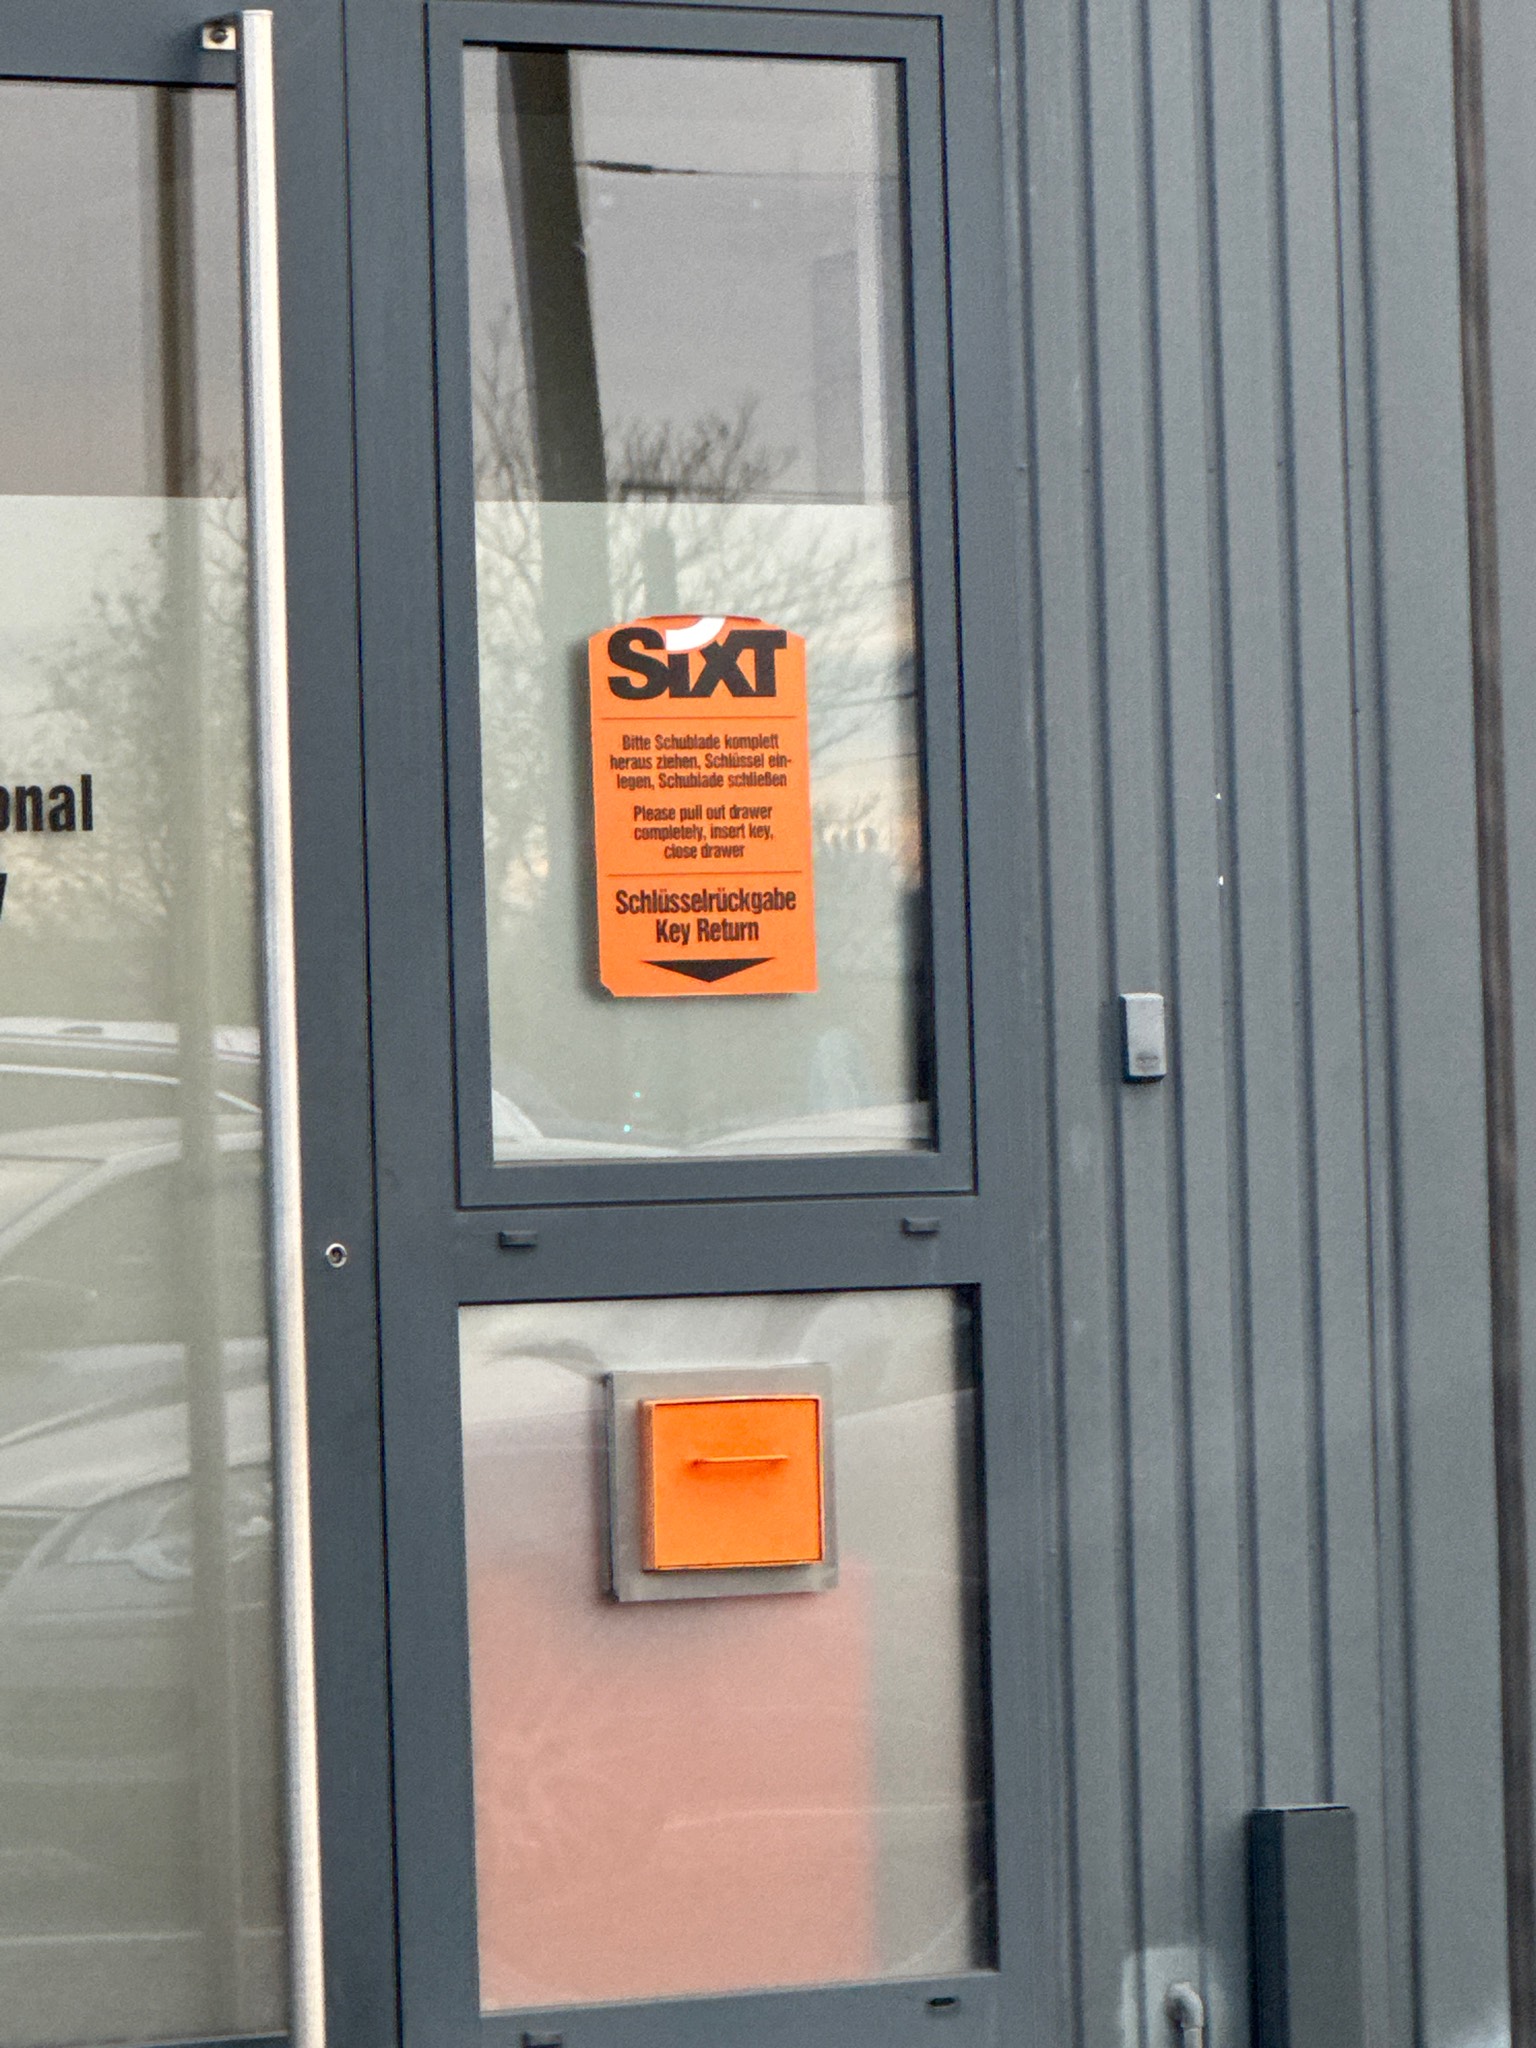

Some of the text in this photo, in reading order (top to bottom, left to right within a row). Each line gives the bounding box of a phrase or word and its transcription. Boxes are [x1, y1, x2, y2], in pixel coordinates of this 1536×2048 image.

[623, 734, 779, 751] Bitte Schublade komplett
[610, 753, 791, 770] heraus ziehen, Schlüssel ein-
[617, 772, 787, 790] legen, Schublade schließen
[634, 804, 772, 822] Please pull out drawer
[634, 823, 773, 842] completely, insert key,
[664, 843, 745, 859] close drawer
[616, 887, 796, 914] Schlüsselrückgabe
[656, 918, 759, 945] Key Return
